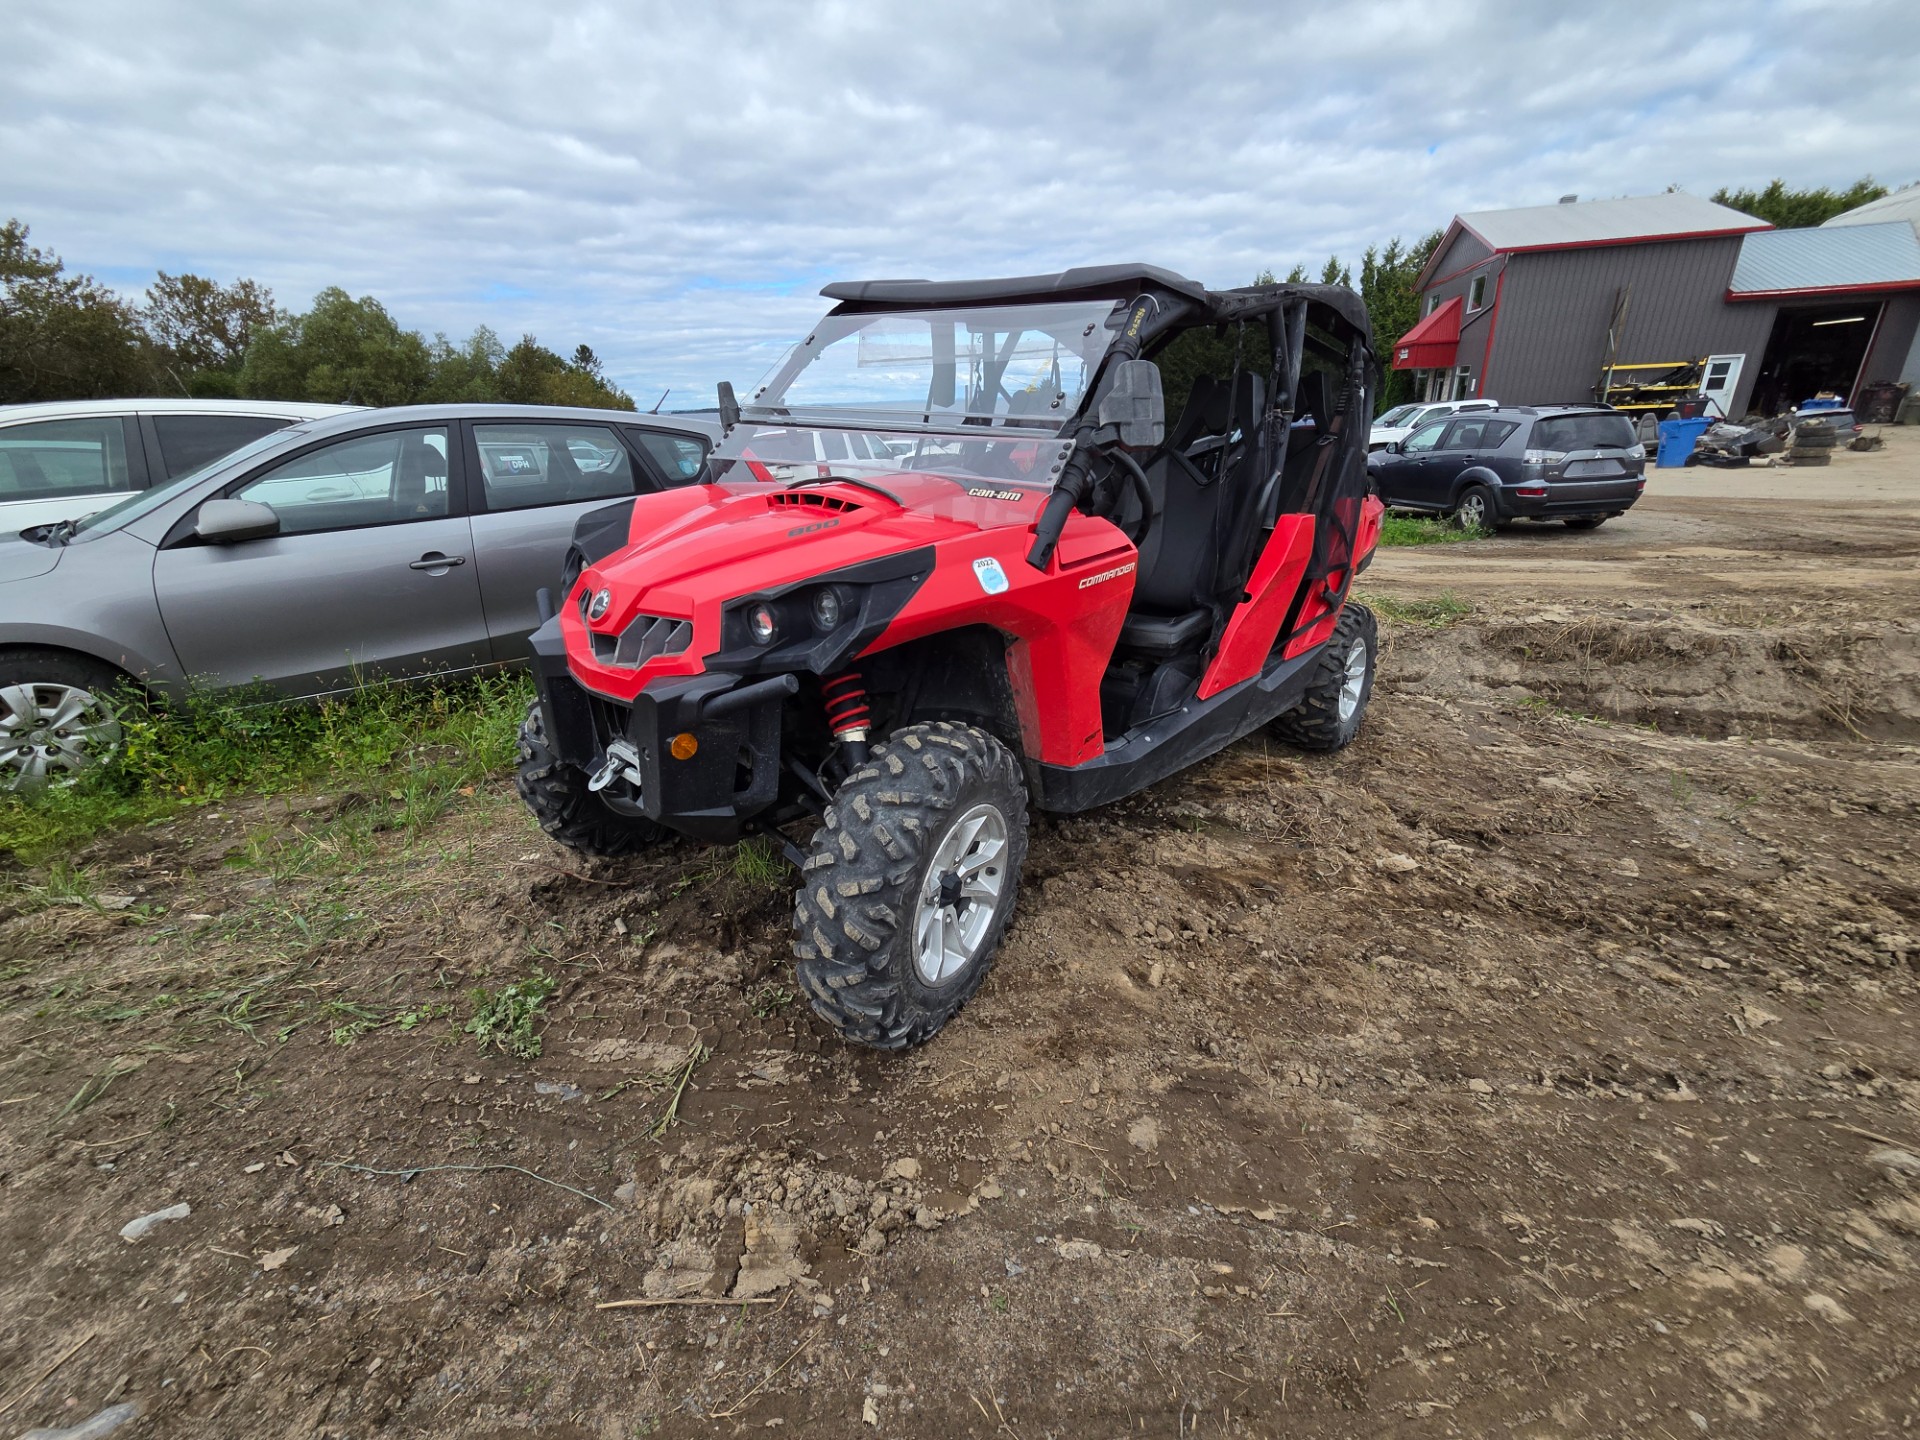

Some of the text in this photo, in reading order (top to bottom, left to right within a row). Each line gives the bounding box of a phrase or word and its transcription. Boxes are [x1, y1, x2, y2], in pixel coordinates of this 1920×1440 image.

[968, 488, 1022, 501] can-am
[976, 558, 994, 568] 2022
[1078, 562, 1136, 590] COMMANDER
